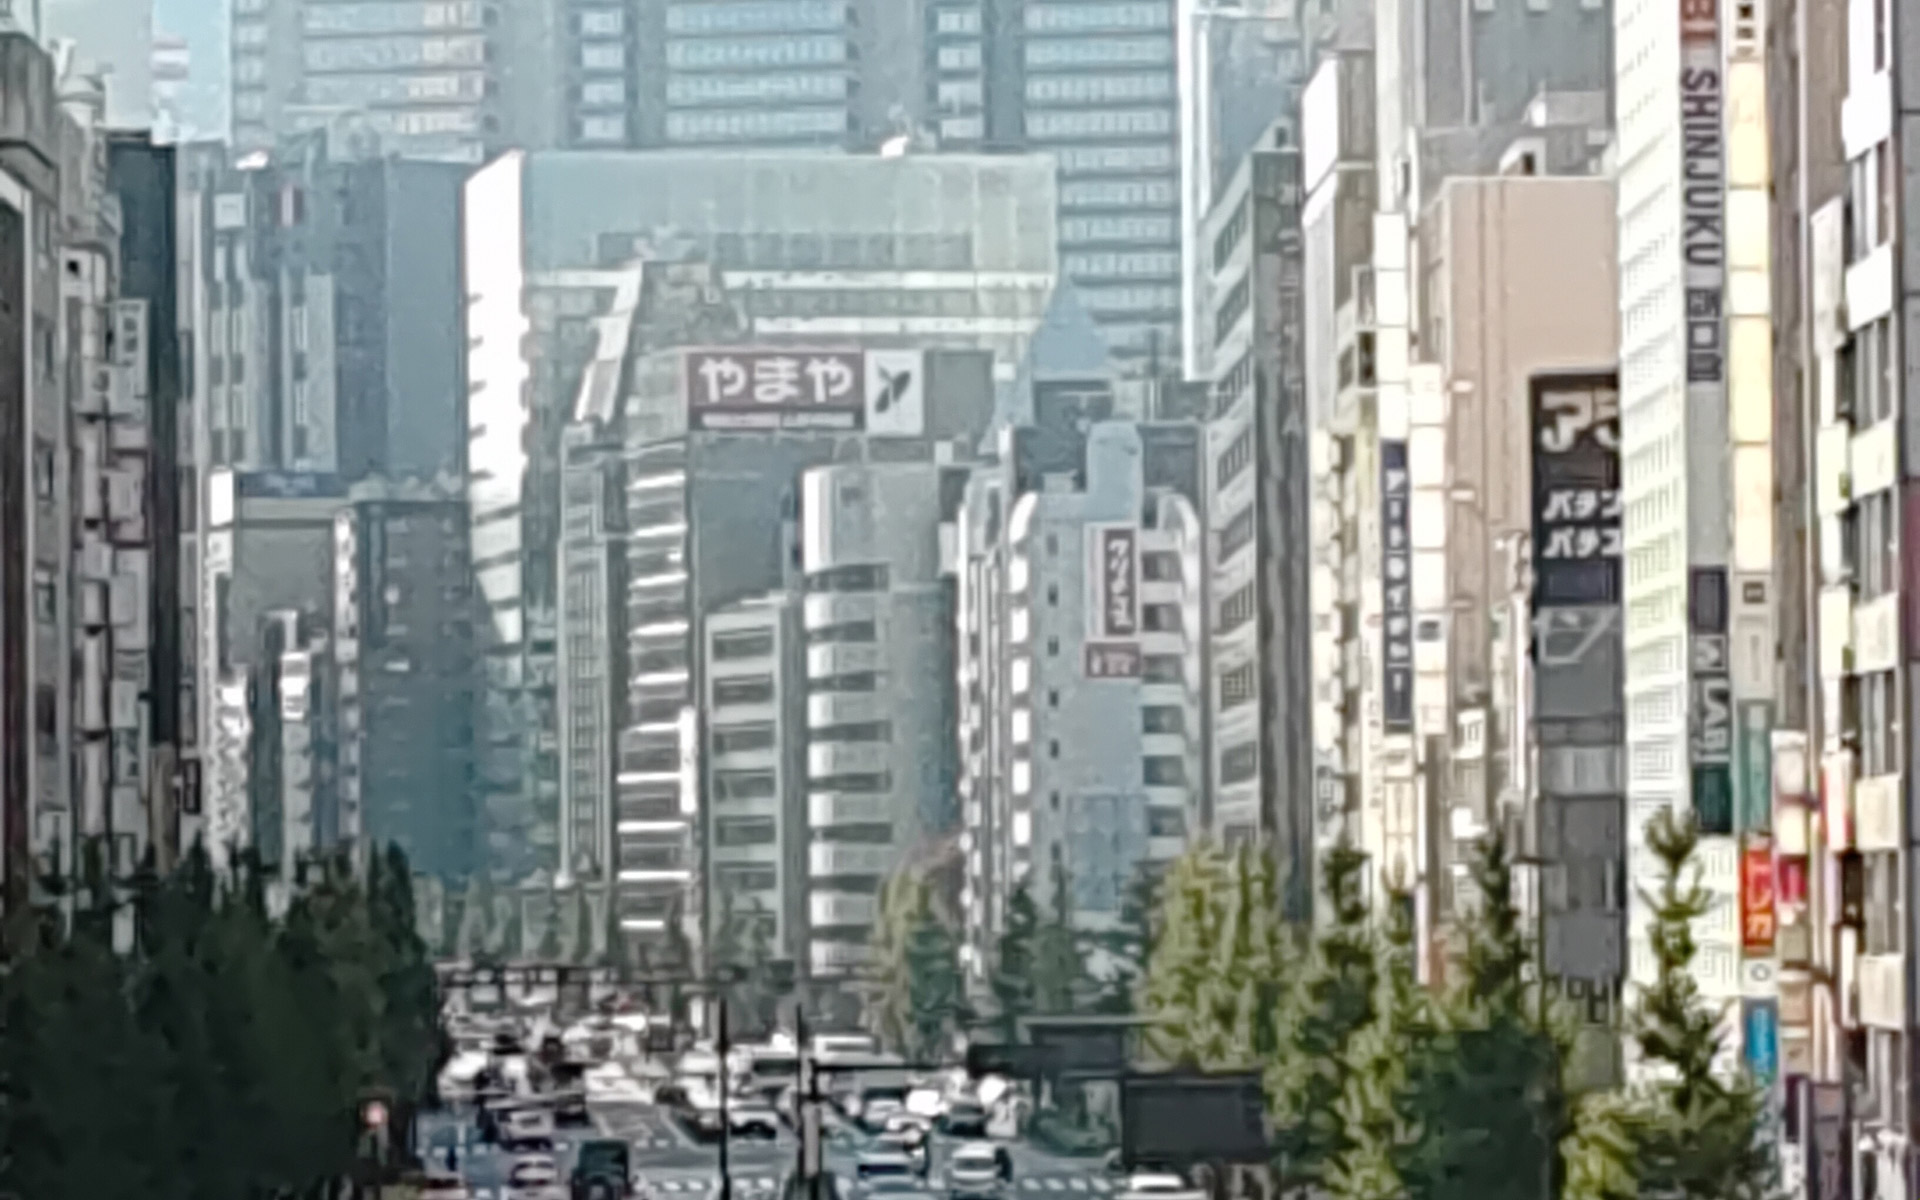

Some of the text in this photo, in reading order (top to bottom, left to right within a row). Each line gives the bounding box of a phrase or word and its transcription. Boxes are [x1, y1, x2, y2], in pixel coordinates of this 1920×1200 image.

[1681, 68, 1721, 266] SHINJUKU
[699, 356, 853, 404] やまや
[1702, 678, 1730, 764] LABI
